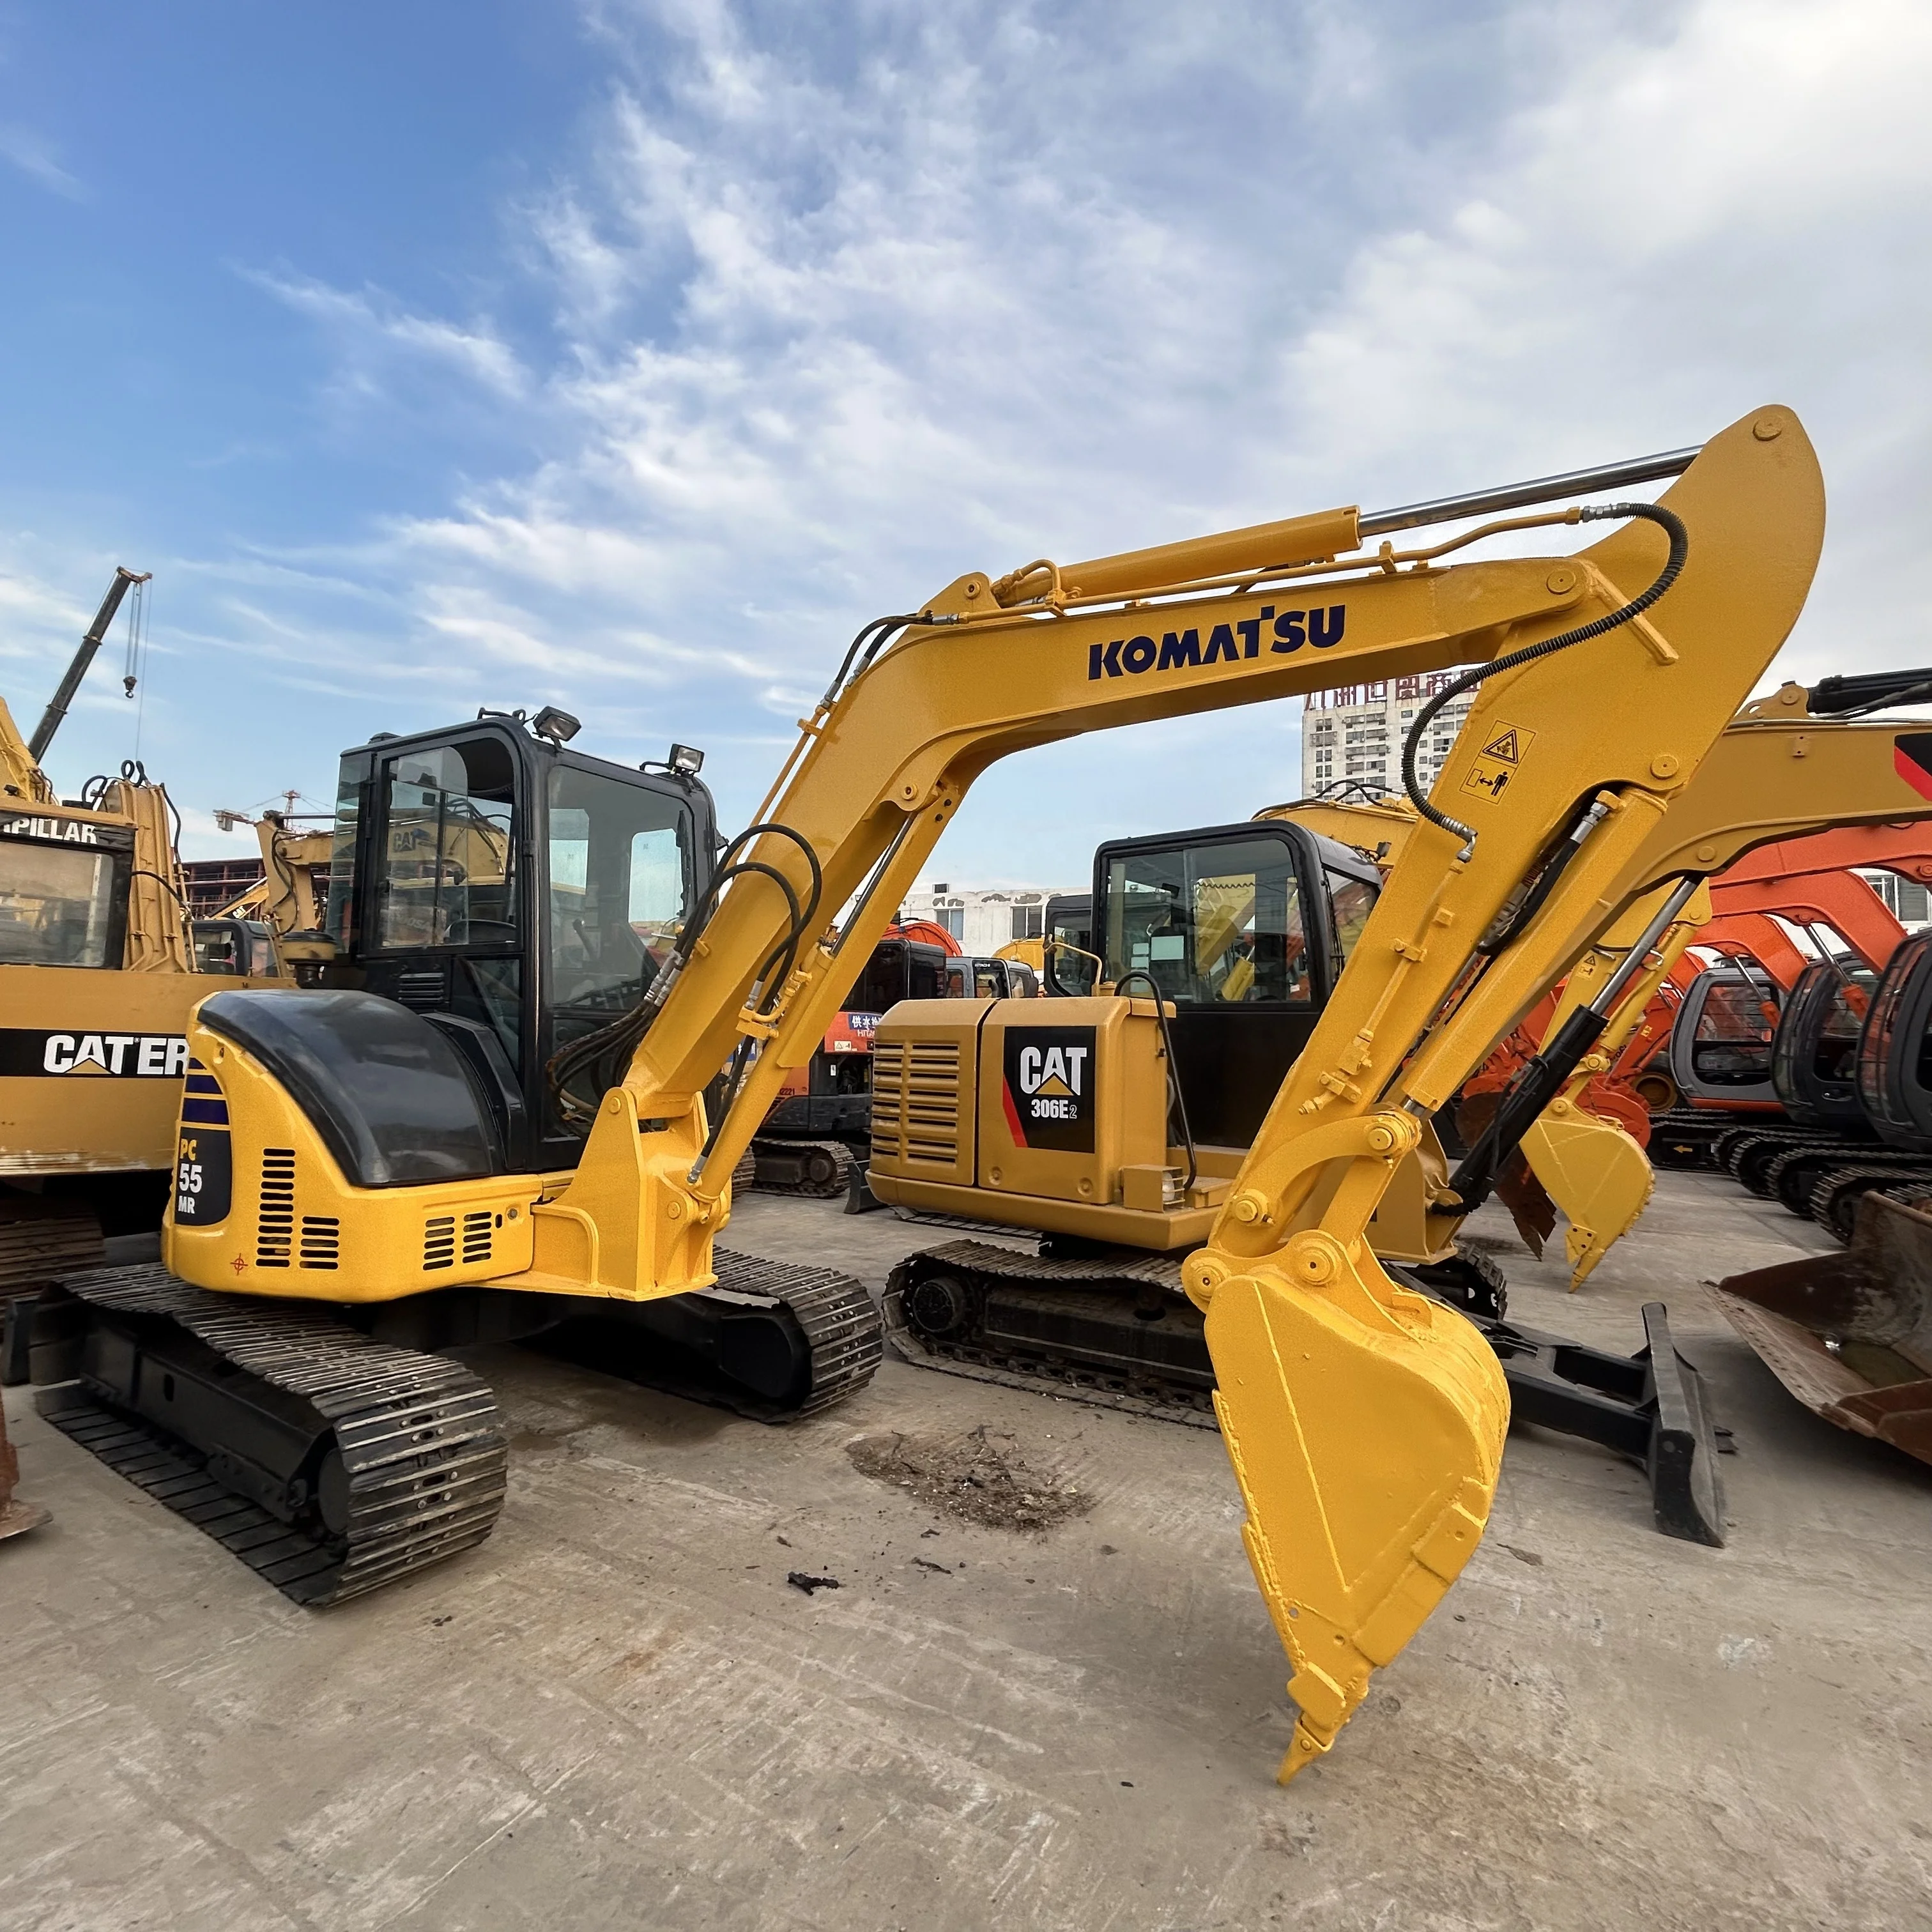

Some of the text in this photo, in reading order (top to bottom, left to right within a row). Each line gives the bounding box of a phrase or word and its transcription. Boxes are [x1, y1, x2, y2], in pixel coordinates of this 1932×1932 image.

[1088, 604, 1346, 680] KOMATSU
[1020, 1046, 1087, 1096] CAT
[180, 1138, 197, 1161] PC
[179, 1163, 203, 1193] 55
[178, 1195, 195, 1215] MR
